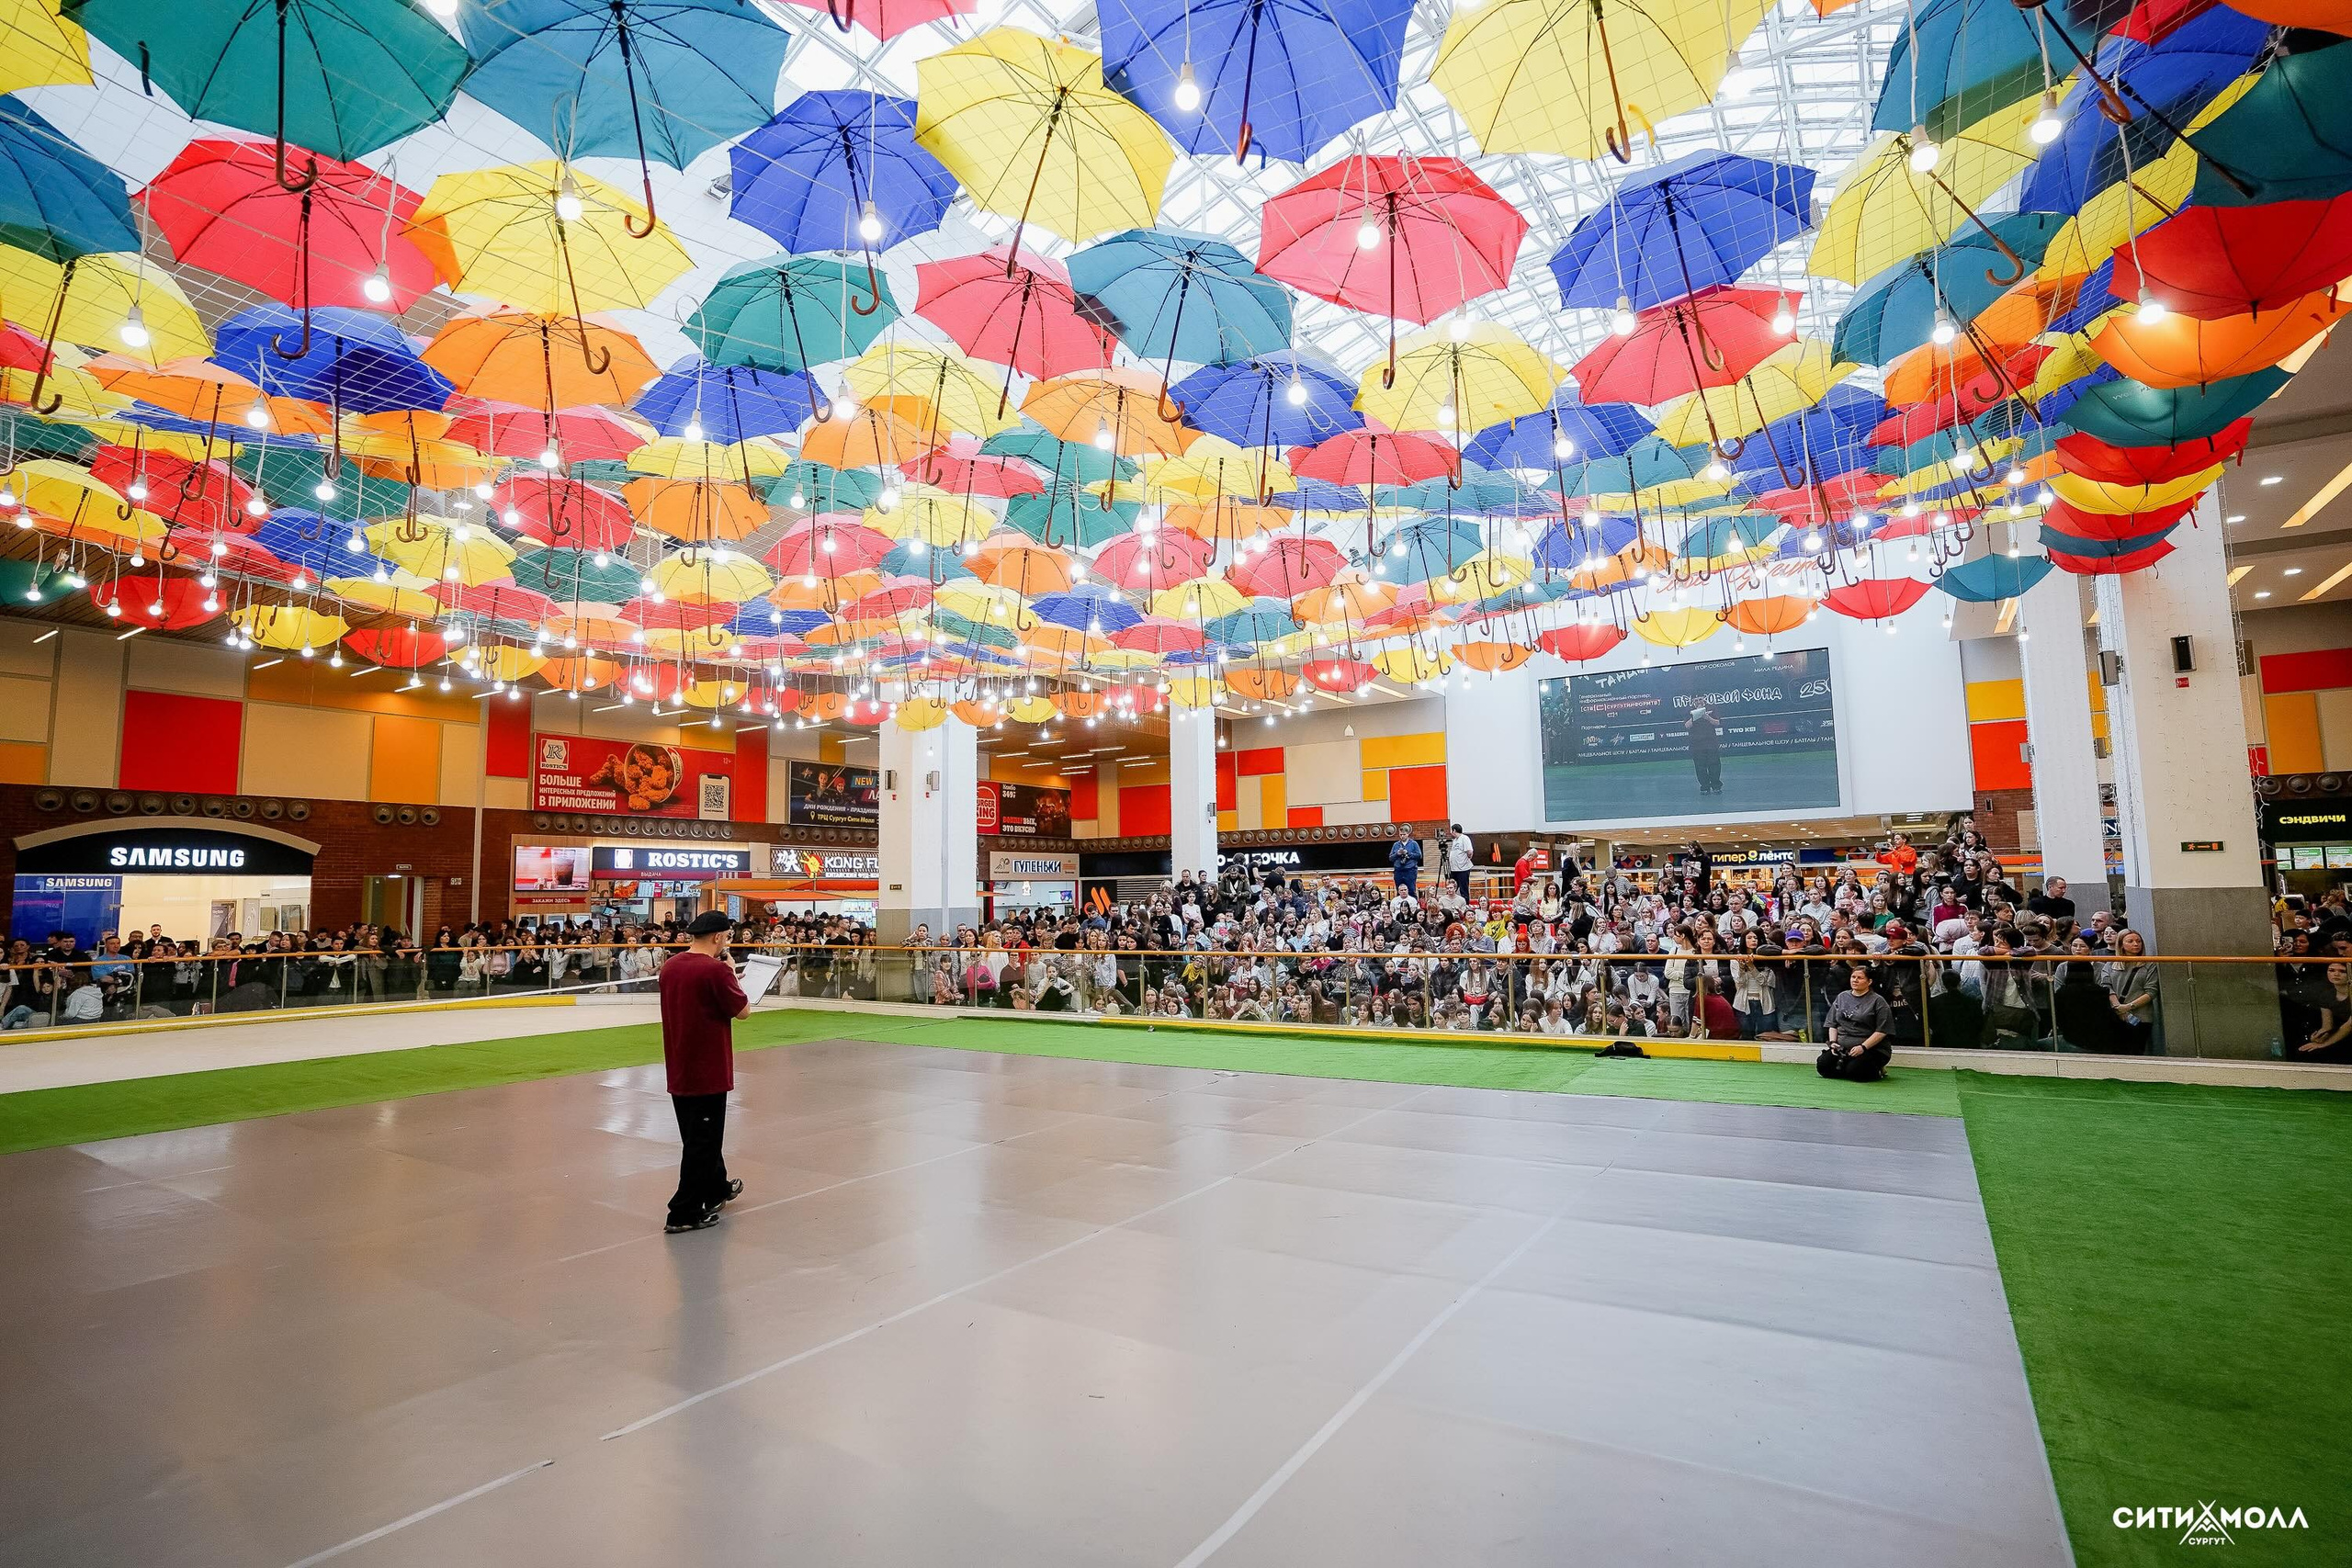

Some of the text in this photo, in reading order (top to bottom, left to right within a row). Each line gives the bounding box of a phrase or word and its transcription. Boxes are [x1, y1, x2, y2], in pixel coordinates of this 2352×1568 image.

[1673, 687, 1782, 708] ПРИОВОЙ ФОНД
[539, 774, 582, 787] БОЛЬШЕ
[854, 777, 874, 785] NEW
[539, 787, 616, 798] ИНТЕРЕСНЫХ ПРЕДЛОЖЕНИЙ
[538, 795, 616, 809] В ПРИЛОЖЕНИИ
[977, 799, 995, 807] URGER
[977, 807, 995, 818] ING
[829, 815, 846, 823] Сургут
[2279, 815, 2346, 824] СЭНДВИЧИ
[109, 847, 245, 867] SAMSUNG
[648, 852, 739, 869] ROSTIC'S
[825, 856, 864, 869] KONG
[1712, 852, 1747, 863] гипер
[1012, 859, 1061, 874] ГУЛЕНЬКИ
[46, 877, 112, 887] SAMSUNG
